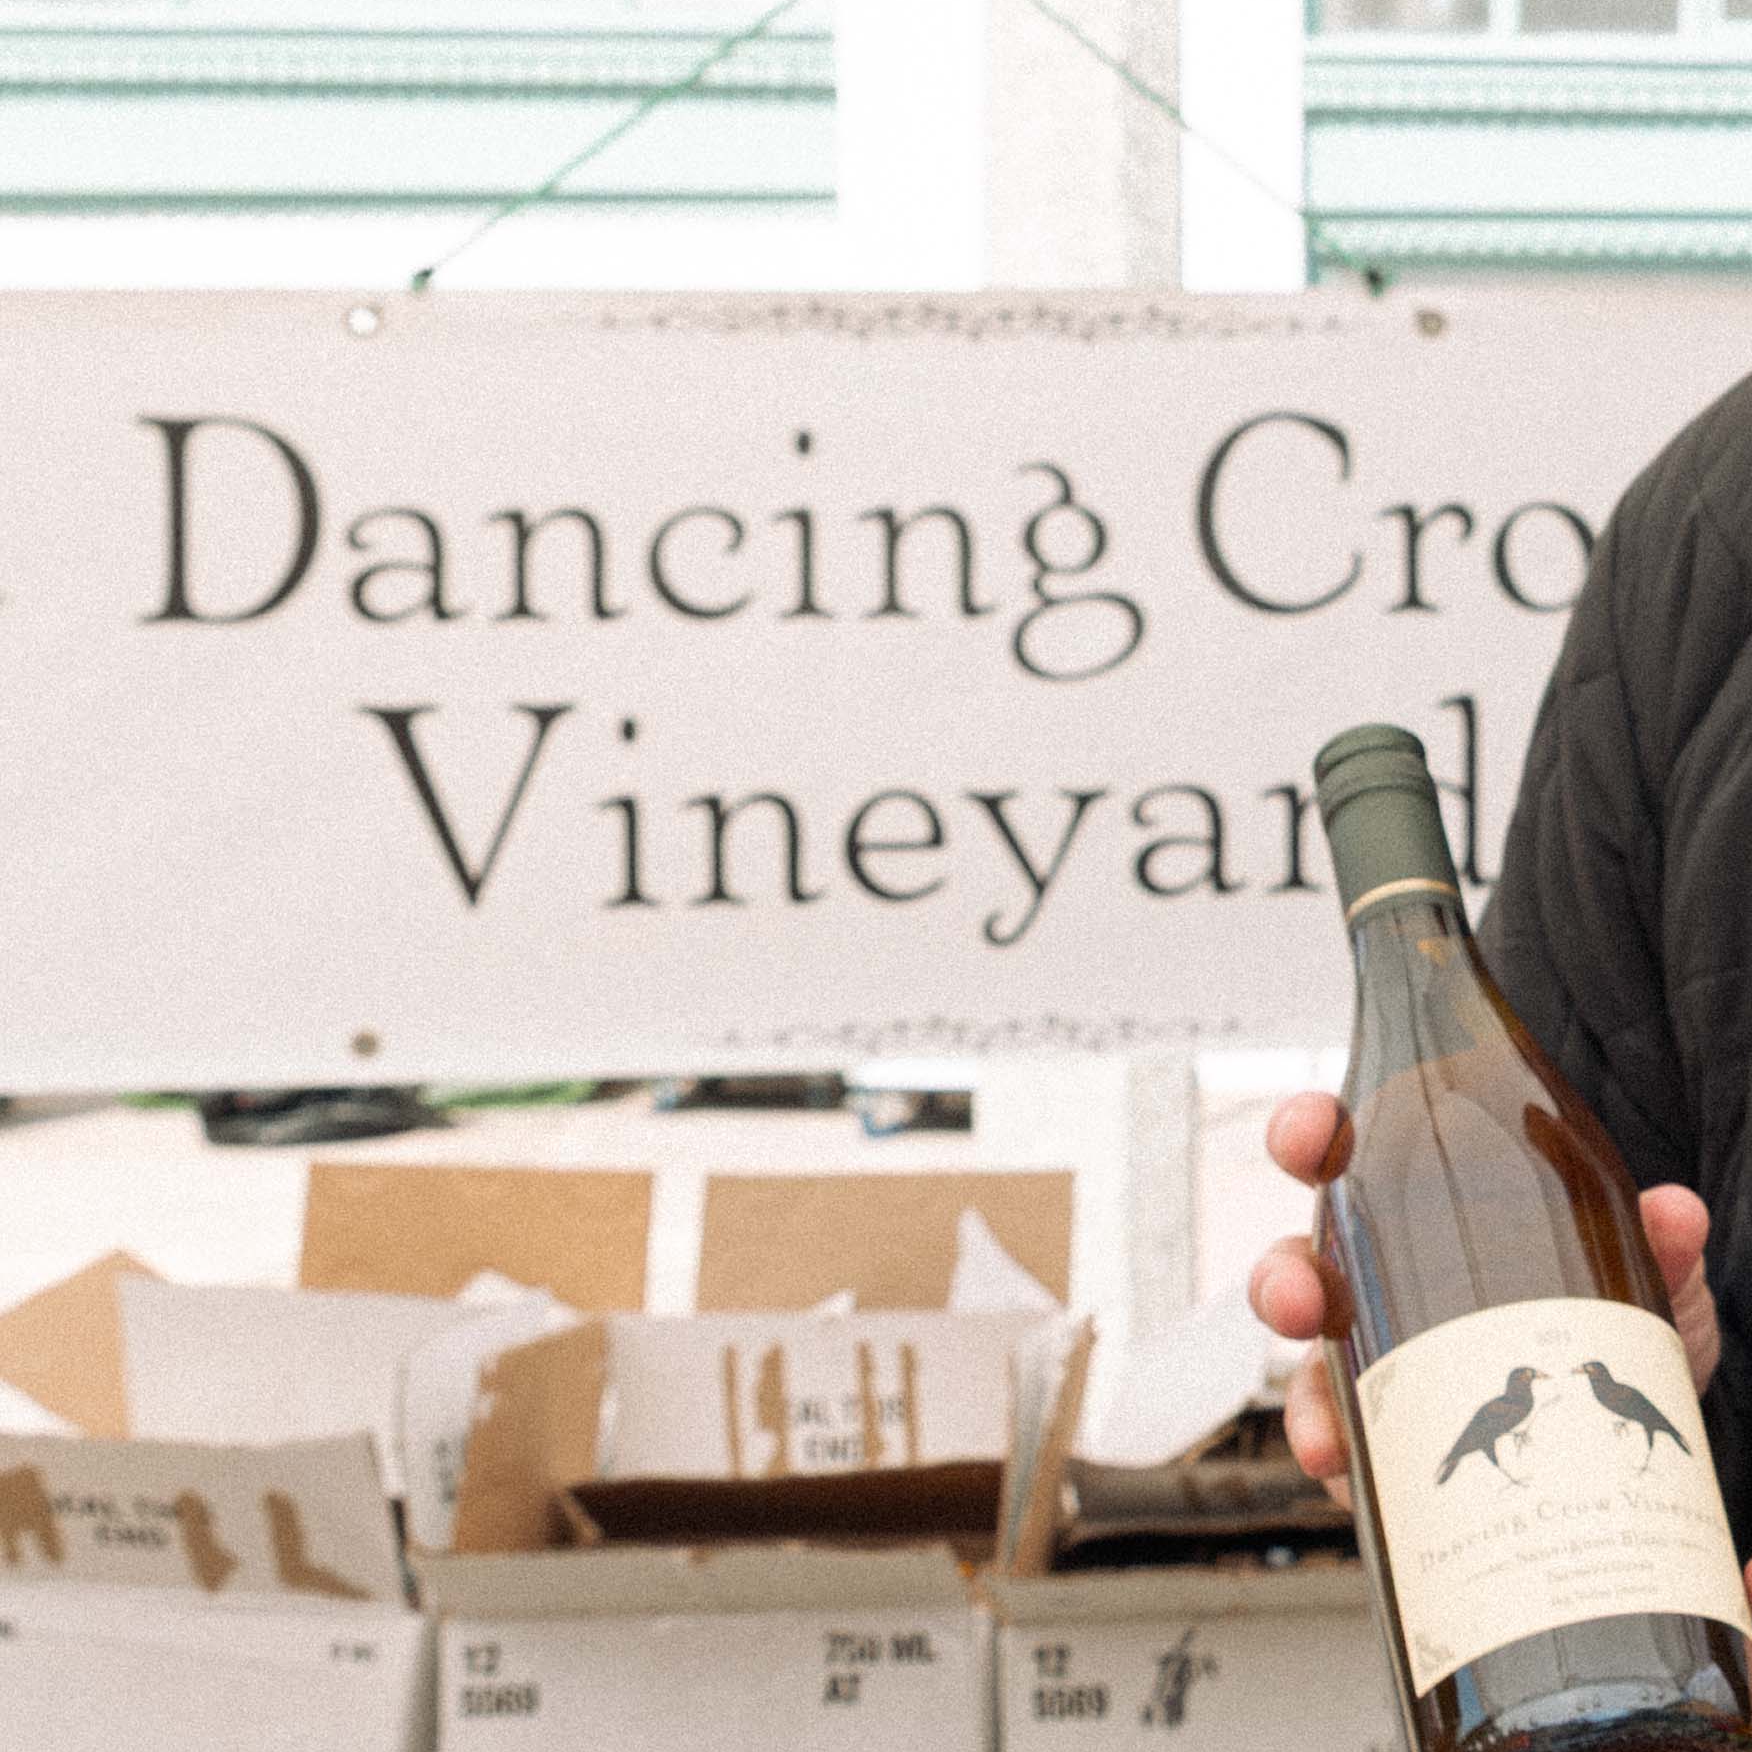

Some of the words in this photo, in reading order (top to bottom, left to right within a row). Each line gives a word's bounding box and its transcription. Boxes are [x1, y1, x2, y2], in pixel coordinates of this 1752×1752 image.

[137, 413, 1145, 681] Dancing
[1198, 410, 1602, 617] Cro
[356, 694, 1504, 948] Vineyard
[1536, 1498, 1611, 1520] Crow
